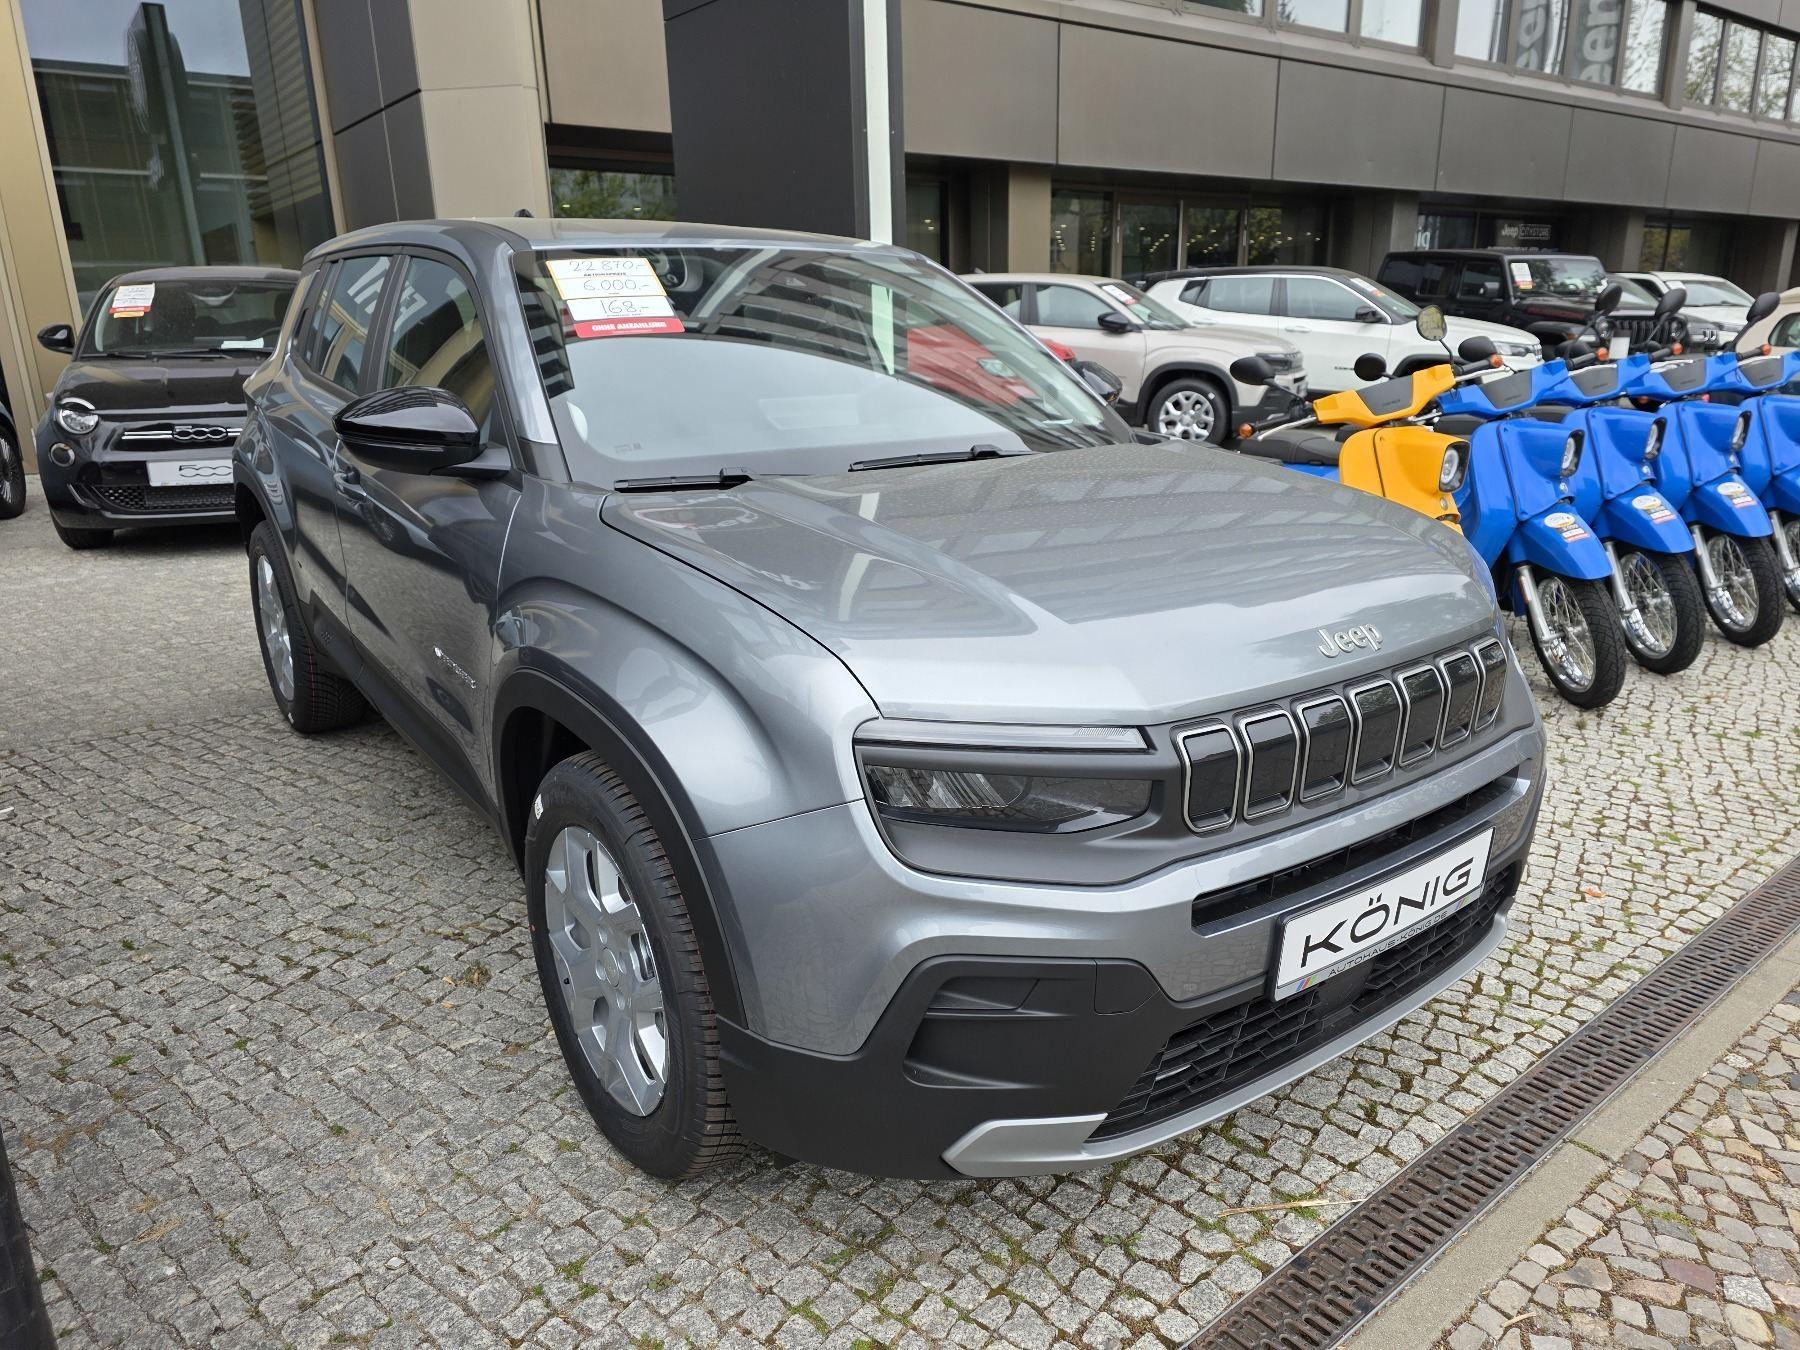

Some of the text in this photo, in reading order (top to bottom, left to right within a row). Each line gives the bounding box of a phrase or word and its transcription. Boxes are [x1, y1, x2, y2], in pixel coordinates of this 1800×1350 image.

[592, 323, 616, 332] OHNE
[173, 425, 227, 440] 500
[179, 464, 232, 477] 500
[1317, 623, 1384, 658] Jeep
[1300, 856, 1475, 969] KÖNIG
